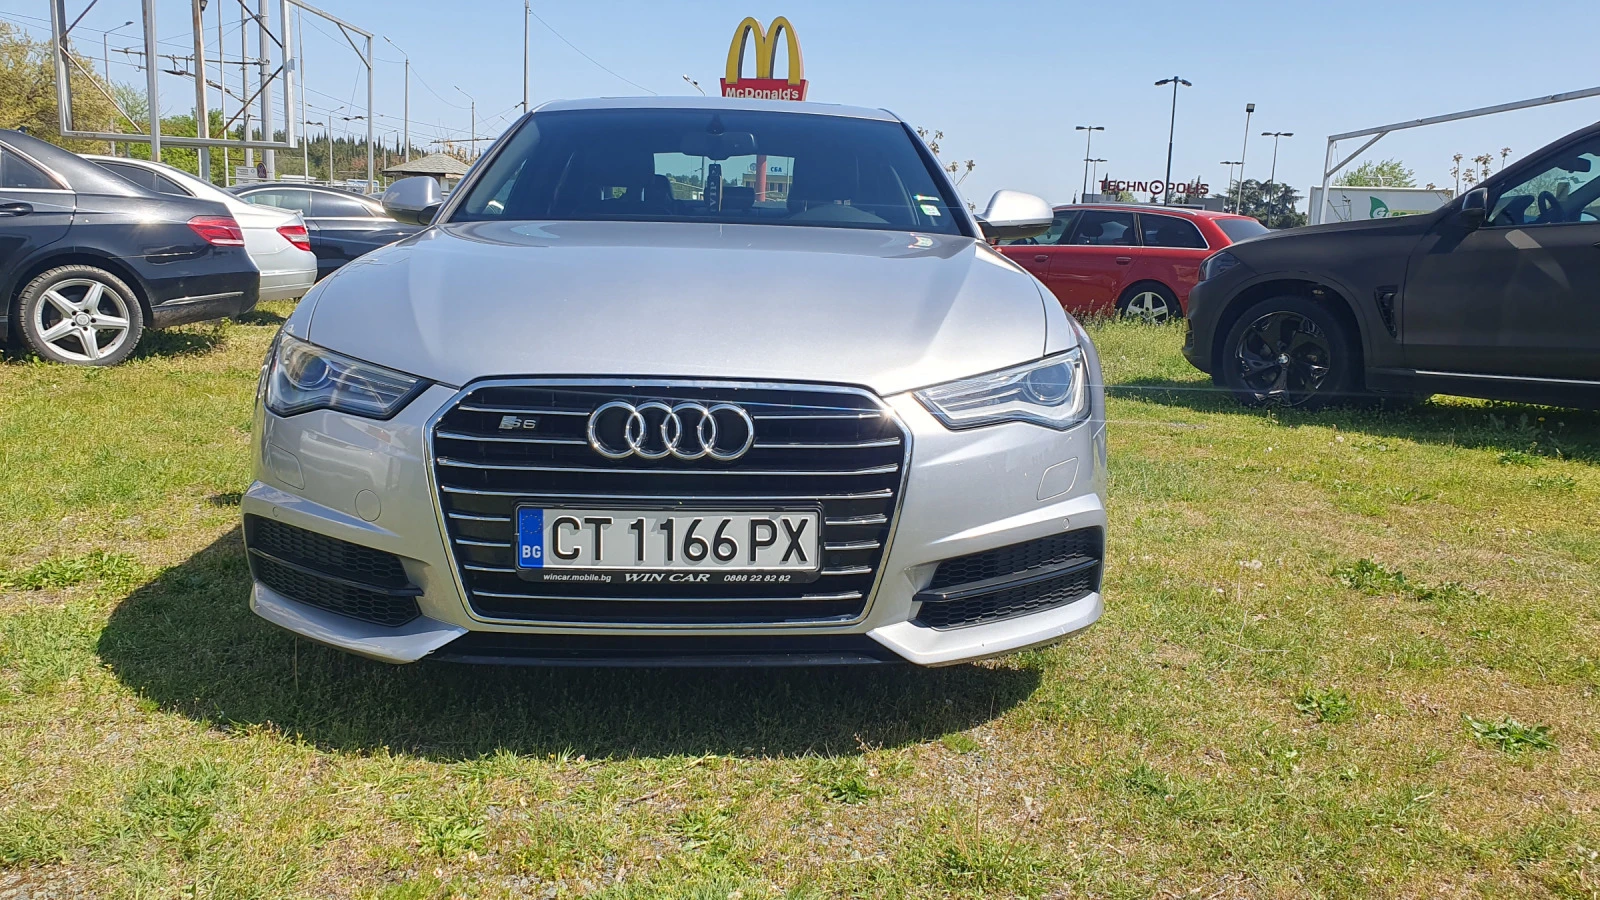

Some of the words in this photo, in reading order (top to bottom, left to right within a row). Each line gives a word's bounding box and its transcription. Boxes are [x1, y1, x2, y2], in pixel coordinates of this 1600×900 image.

[726, 87, 799, 100] McDonald's
[1099, 180, 1209, 195] TECHNOPOLIS
[552, 516, 613, 561] CT
[629, 517, 738, 562] 1166
[749, 518, 810, 562] PX
[522, 545, 541, 559] BG
[543, 573, 612, 583] wincar.mobile.bg
[624, 573, 666, 582] WIN
[668, 573, 711, 582] CAR
[723, 574, 748, 582] 0888
[749, 574, 762, 582] 22
[763, 574, 777, 582] 82
[778, 574, 791, 583] 82
